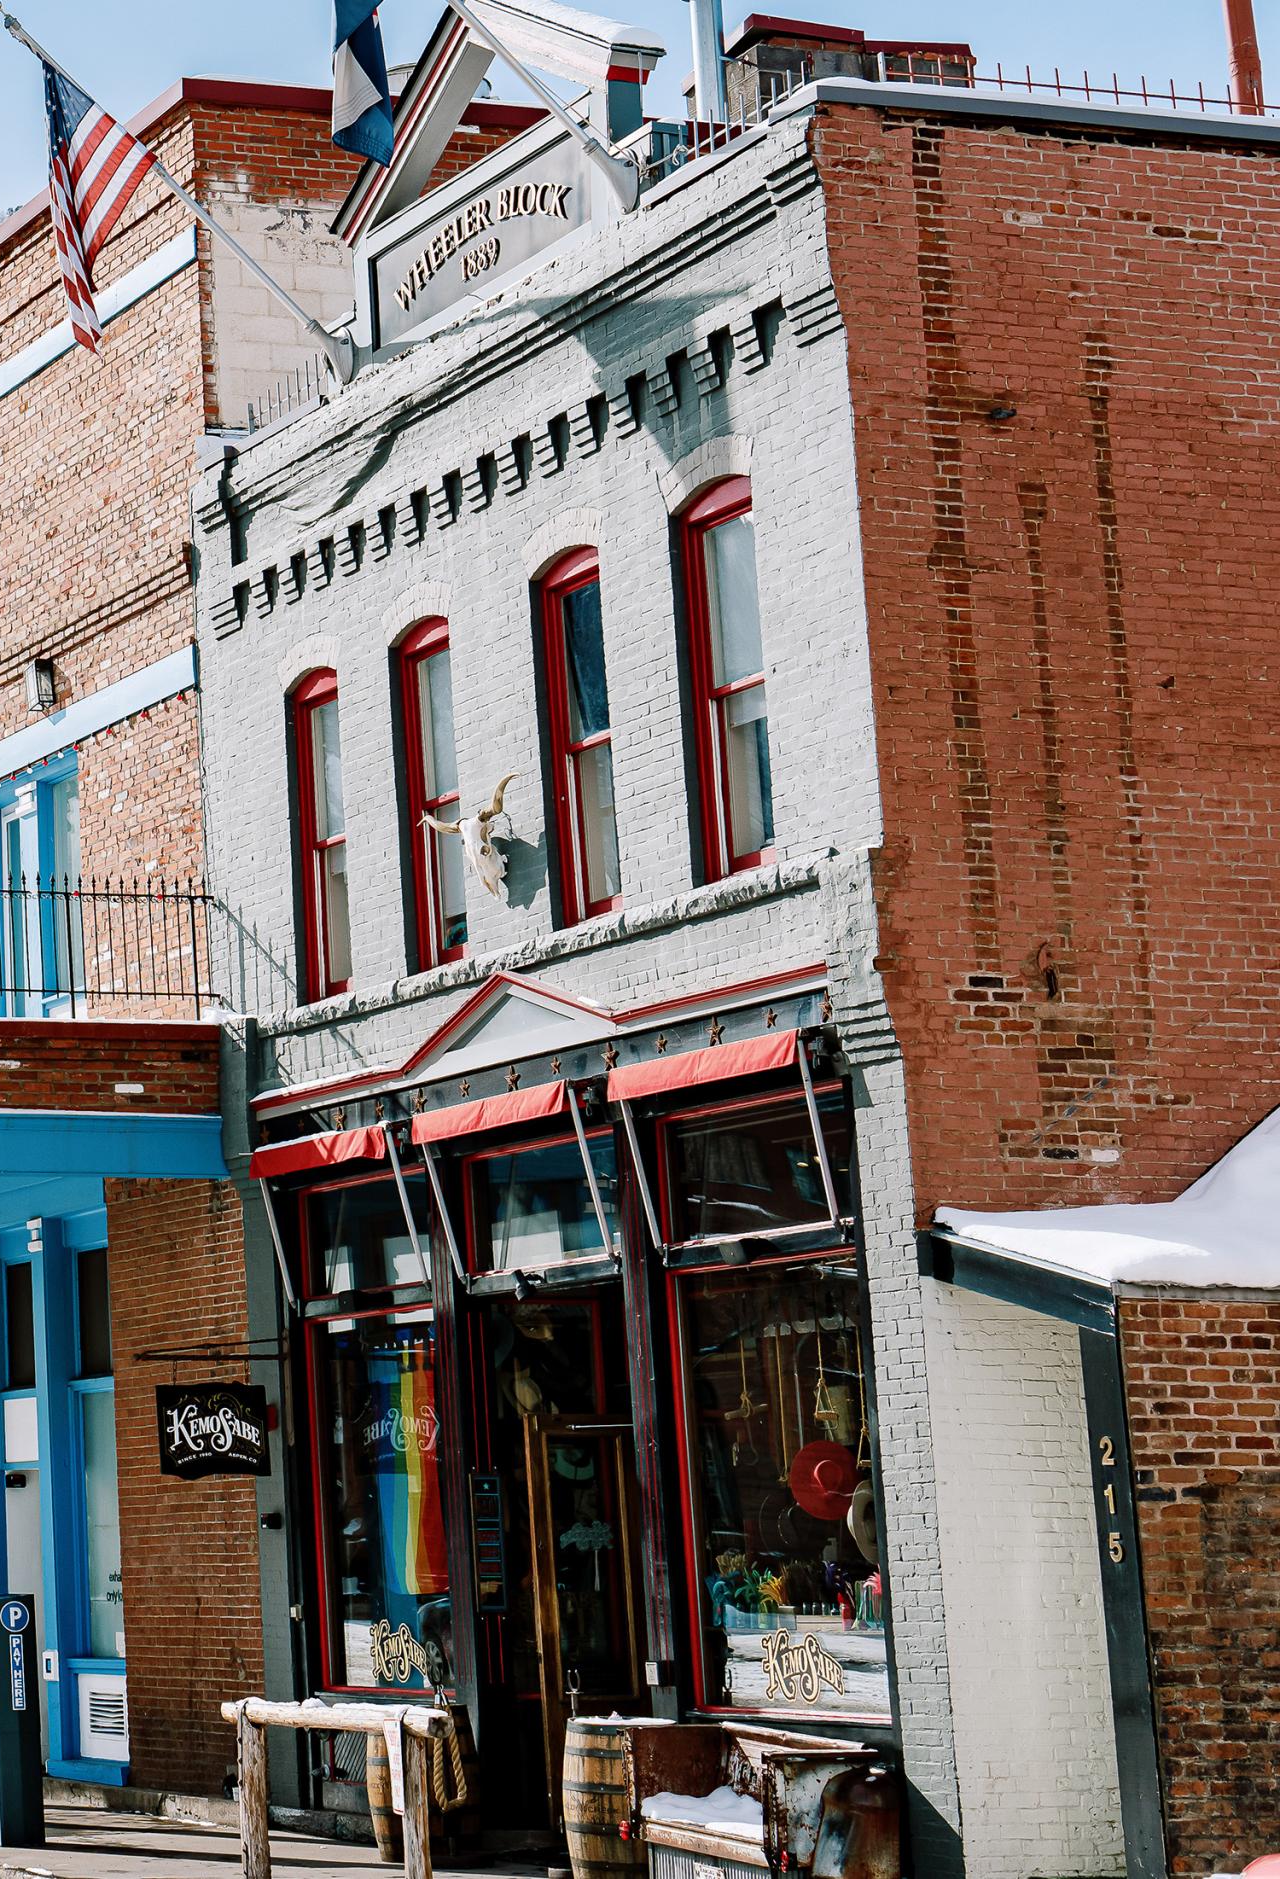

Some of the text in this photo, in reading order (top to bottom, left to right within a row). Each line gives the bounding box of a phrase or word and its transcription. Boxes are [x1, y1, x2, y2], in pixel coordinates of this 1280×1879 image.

[393, 182, 572, 312] WHEELER BLOCK
[460, 237, 500, 283] 1889
[12, 1637, 24, 1707] PAY HERE
